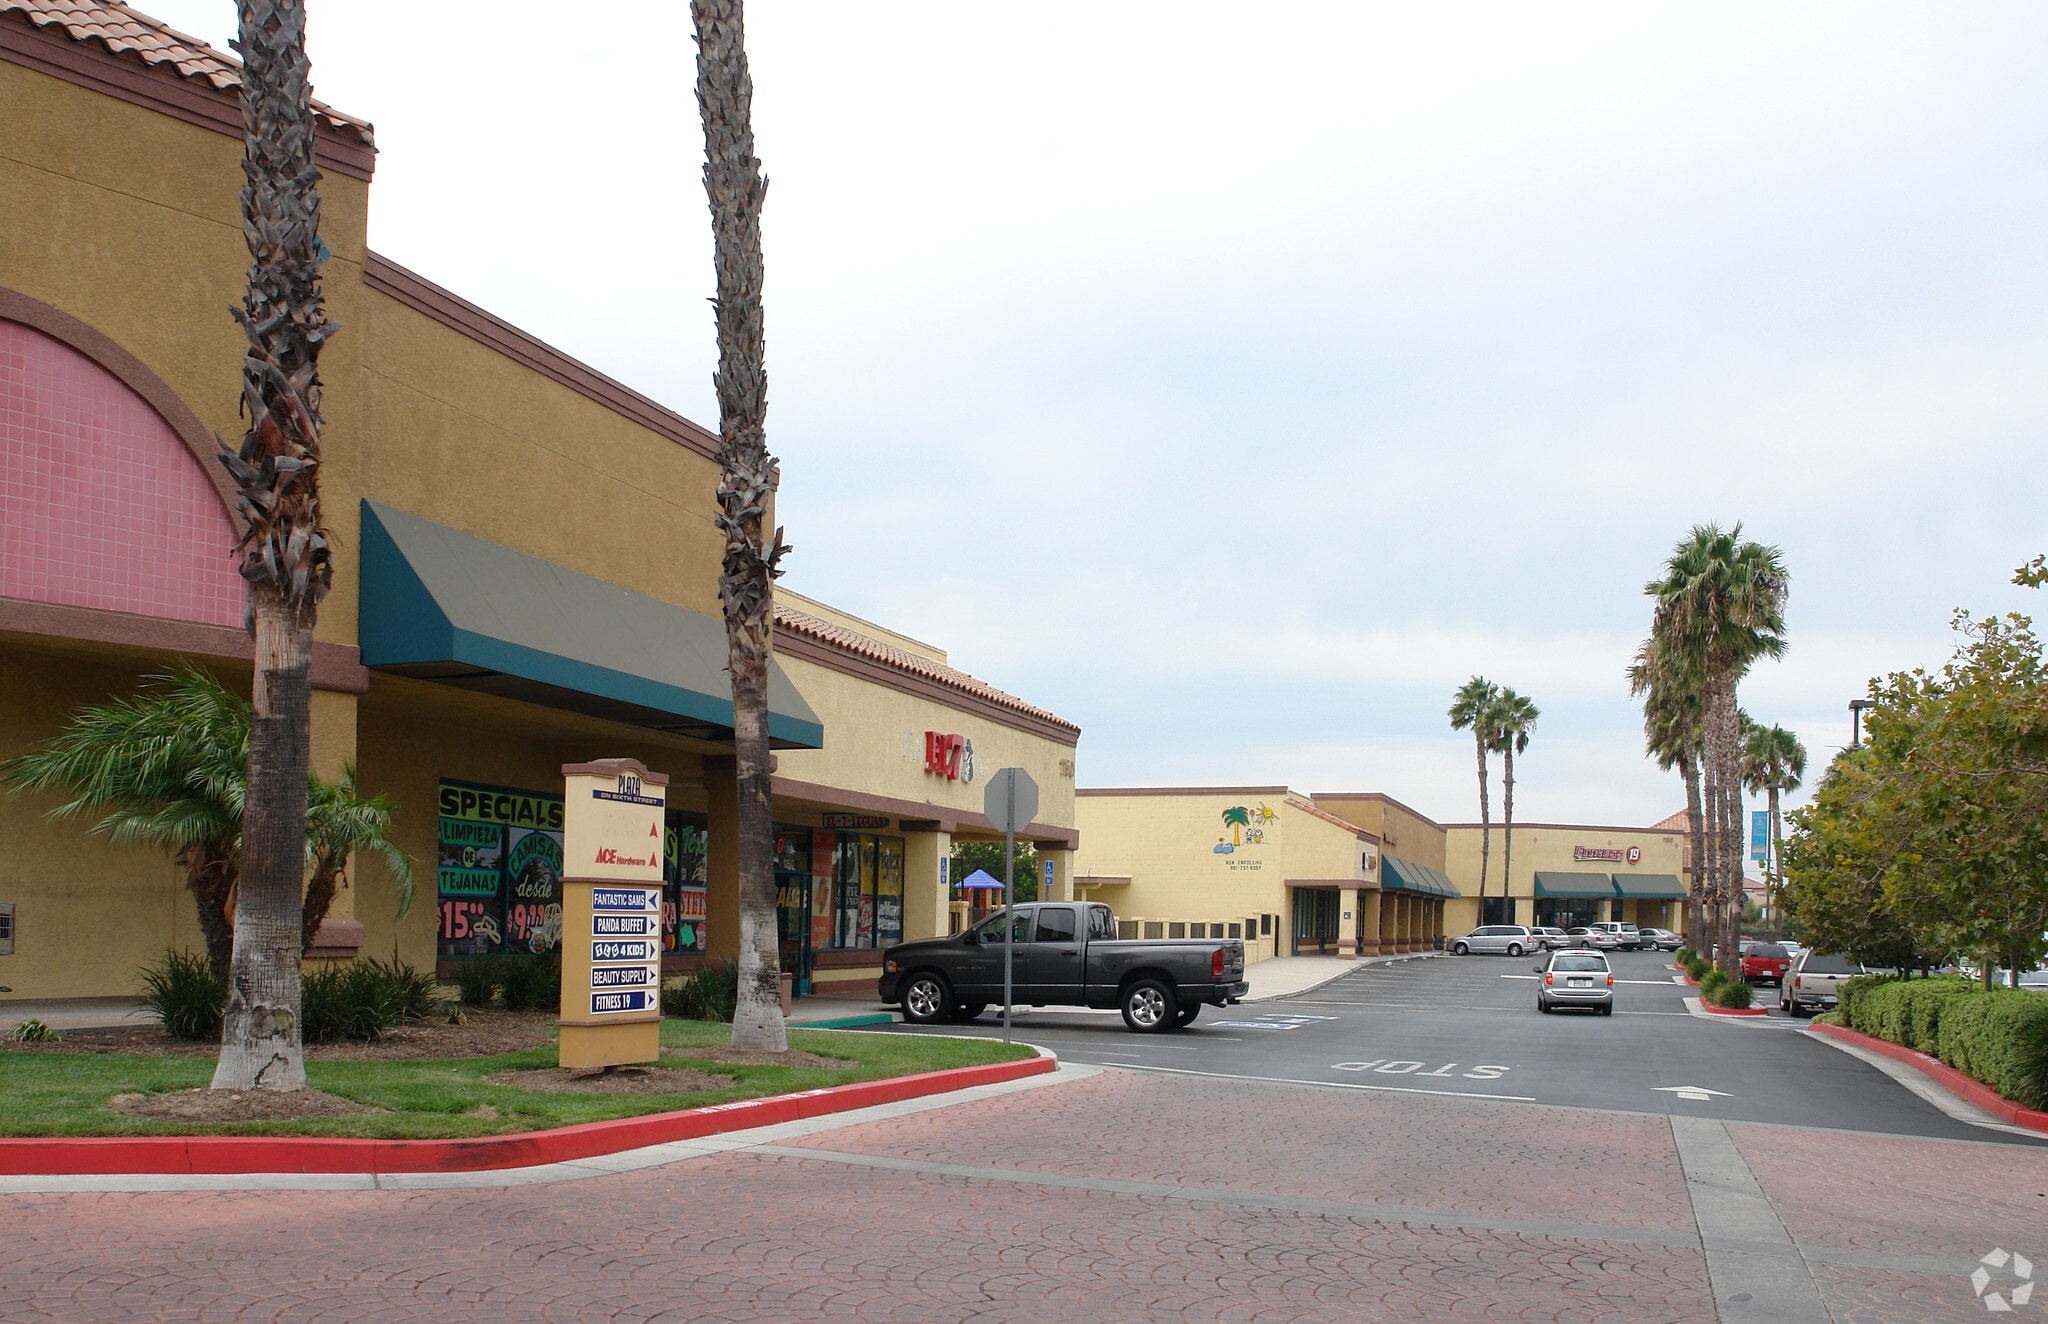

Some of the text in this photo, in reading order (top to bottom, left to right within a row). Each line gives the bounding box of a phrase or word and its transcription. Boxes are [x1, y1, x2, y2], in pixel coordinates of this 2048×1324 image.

[618, 775, 641, 796] PLAZA
[612, 793, 632, 802] SIXTH
[634, 795, 657, 804] STREET
[440, 788, 563, 828] SPECIALS
[443, 821, 499, 845] LIMPIEZA
[464, 850, 475, 864] DE
[510, 834, 563, 876] CAMISAS
[595, 846, 647, 867] ACE Hardware
[1629, 848, 1640, 861] 19
[440, 870, 496, 892] TEJANAS
[515, 874, 553, 898] desde
[594, 893, 645, 906] FANTASTIC SAMS
[598, 918, 644, 933] PANDA BUFFET
[620, 944, 626, 956] 4
[626, 944, 645, 956] KIDS
[593, 969, 646, 985] BEAUTY SUPPLY
[596, 995, 631, 1010] FITNESS 19
[1330, 1059, 1510, 1079] STOP
